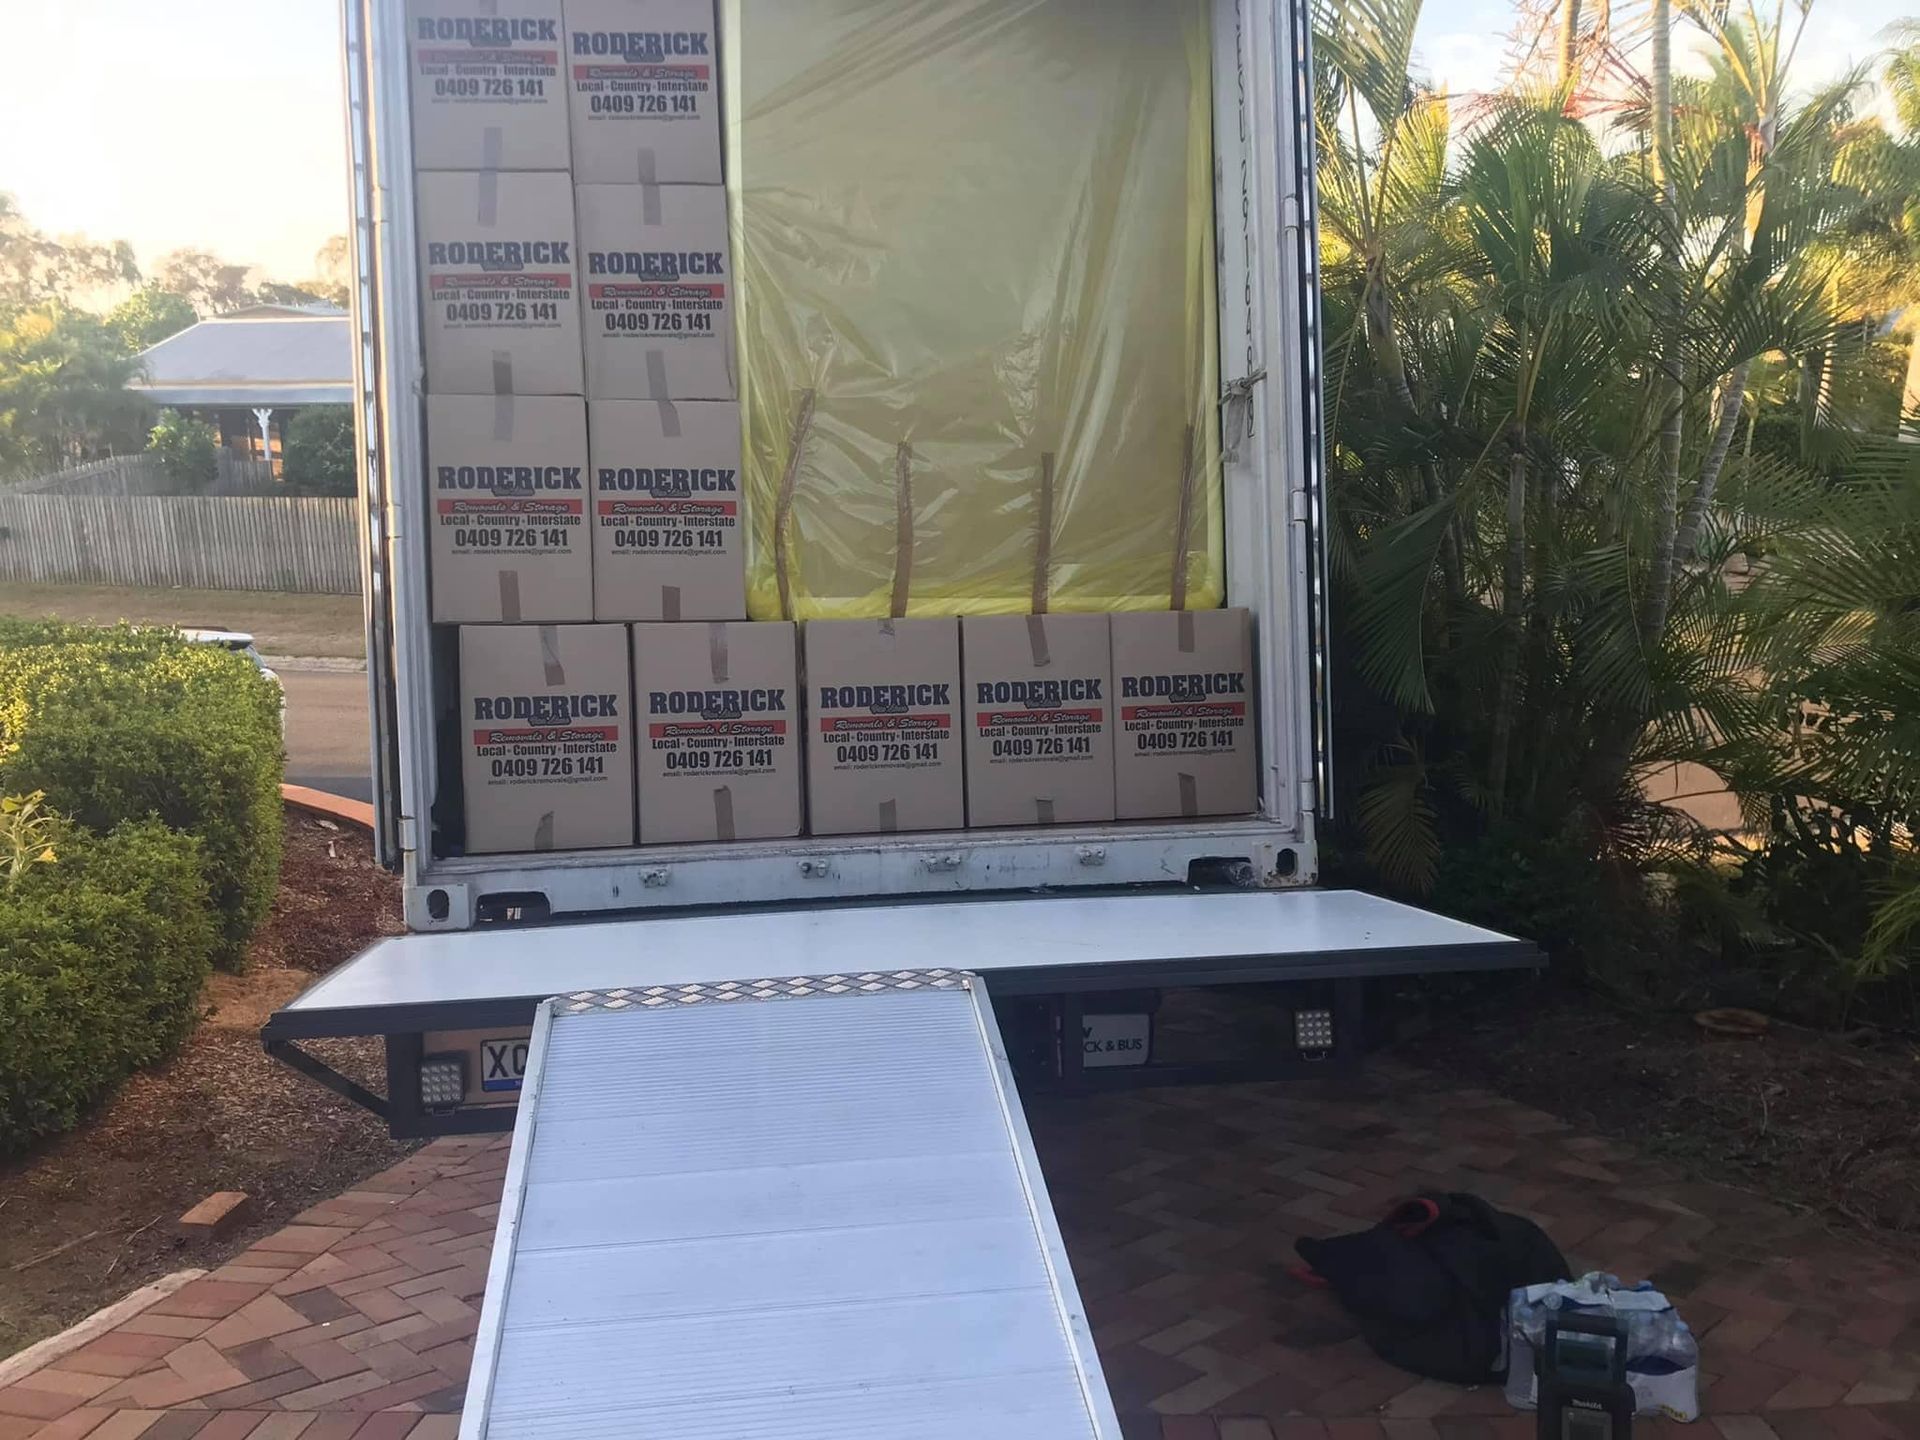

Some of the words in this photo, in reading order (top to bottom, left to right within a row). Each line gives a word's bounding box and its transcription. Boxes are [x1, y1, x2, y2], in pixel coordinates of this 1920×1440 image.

[417, 18, 557, 41] RODERICK
[573, 32, 708, 55] RODERICK
[435, 79, 479, 96] 0409
[483, 79, 513, 96] 726
[517, 79, 544, 96] 141
[591, 95, 634, 112] 0409
[638, 95, 667, 112] 726
[670, 96, 697, 112] 141
[429, 242, 570, 264] RODERICK
[588, 252, 724, 274] RODERICK
[446, 303, 492, 320] 0409
[495, 303, 527, 320] 726
[530, 303, 557, 320] 141
[606, 313, 649, 330] 0409
[652, 313, 682, 330] 726
[685, 313, 711, 330] 141
[438, 466, 582, 489] RODERICK
[598, 468, 736, 491] RODERICK
[613, 503, 664, 514] Removals
[668, 503, 678, 512] &
[680, 503, 724, 516] Storage
[455, 529, 501, 546] 0409
[505, 529, 537, 546] 726
[541, 529, 568, 546] 141
[615, 530, 659, 547] 0409
[663, 530, 693, 547] 726
[697, 530, 722, 547] 141
[977, 679, 1102, 703] RODERICK
[1121, 673, 1245, 697] RODERICK
[649, 689, 785, 714] RODERICK
[820, 684, 950, 708] RODERICK
[474, 695, 618, 720] RODERICK
[490, 732, 543, 743] Removals
[546, 731, 557, 740] &
[560, 730, 604, 743] Storage
[719, 724, 728, 733] &
[993, 739, 1033, 756] 0409
[1036, 738, 1063, 754] 726
[1066, 737, 1090, 753] 141
[1137, 733, 1177, 750] 0409
[1180, 731, 1207, 748] 726
[1210, 730, 1233, 746] 141
[666, 752, 710, 769] 0409
[714, 751, 743, 767] 726
[747, 749, 772, 766] 141
[837, 745, 878, 763] 0409
[882, 744, 910, 760] 726
[914, 743, 938, 759] 141
[492, 759, 538, 777] 0409
[542, 757, 573, 775] 726
[577, 756, 603, 774] 141
[1105, 1040, 1114, 1051] &
[1118, 1038, 1142, 1050] BUS
